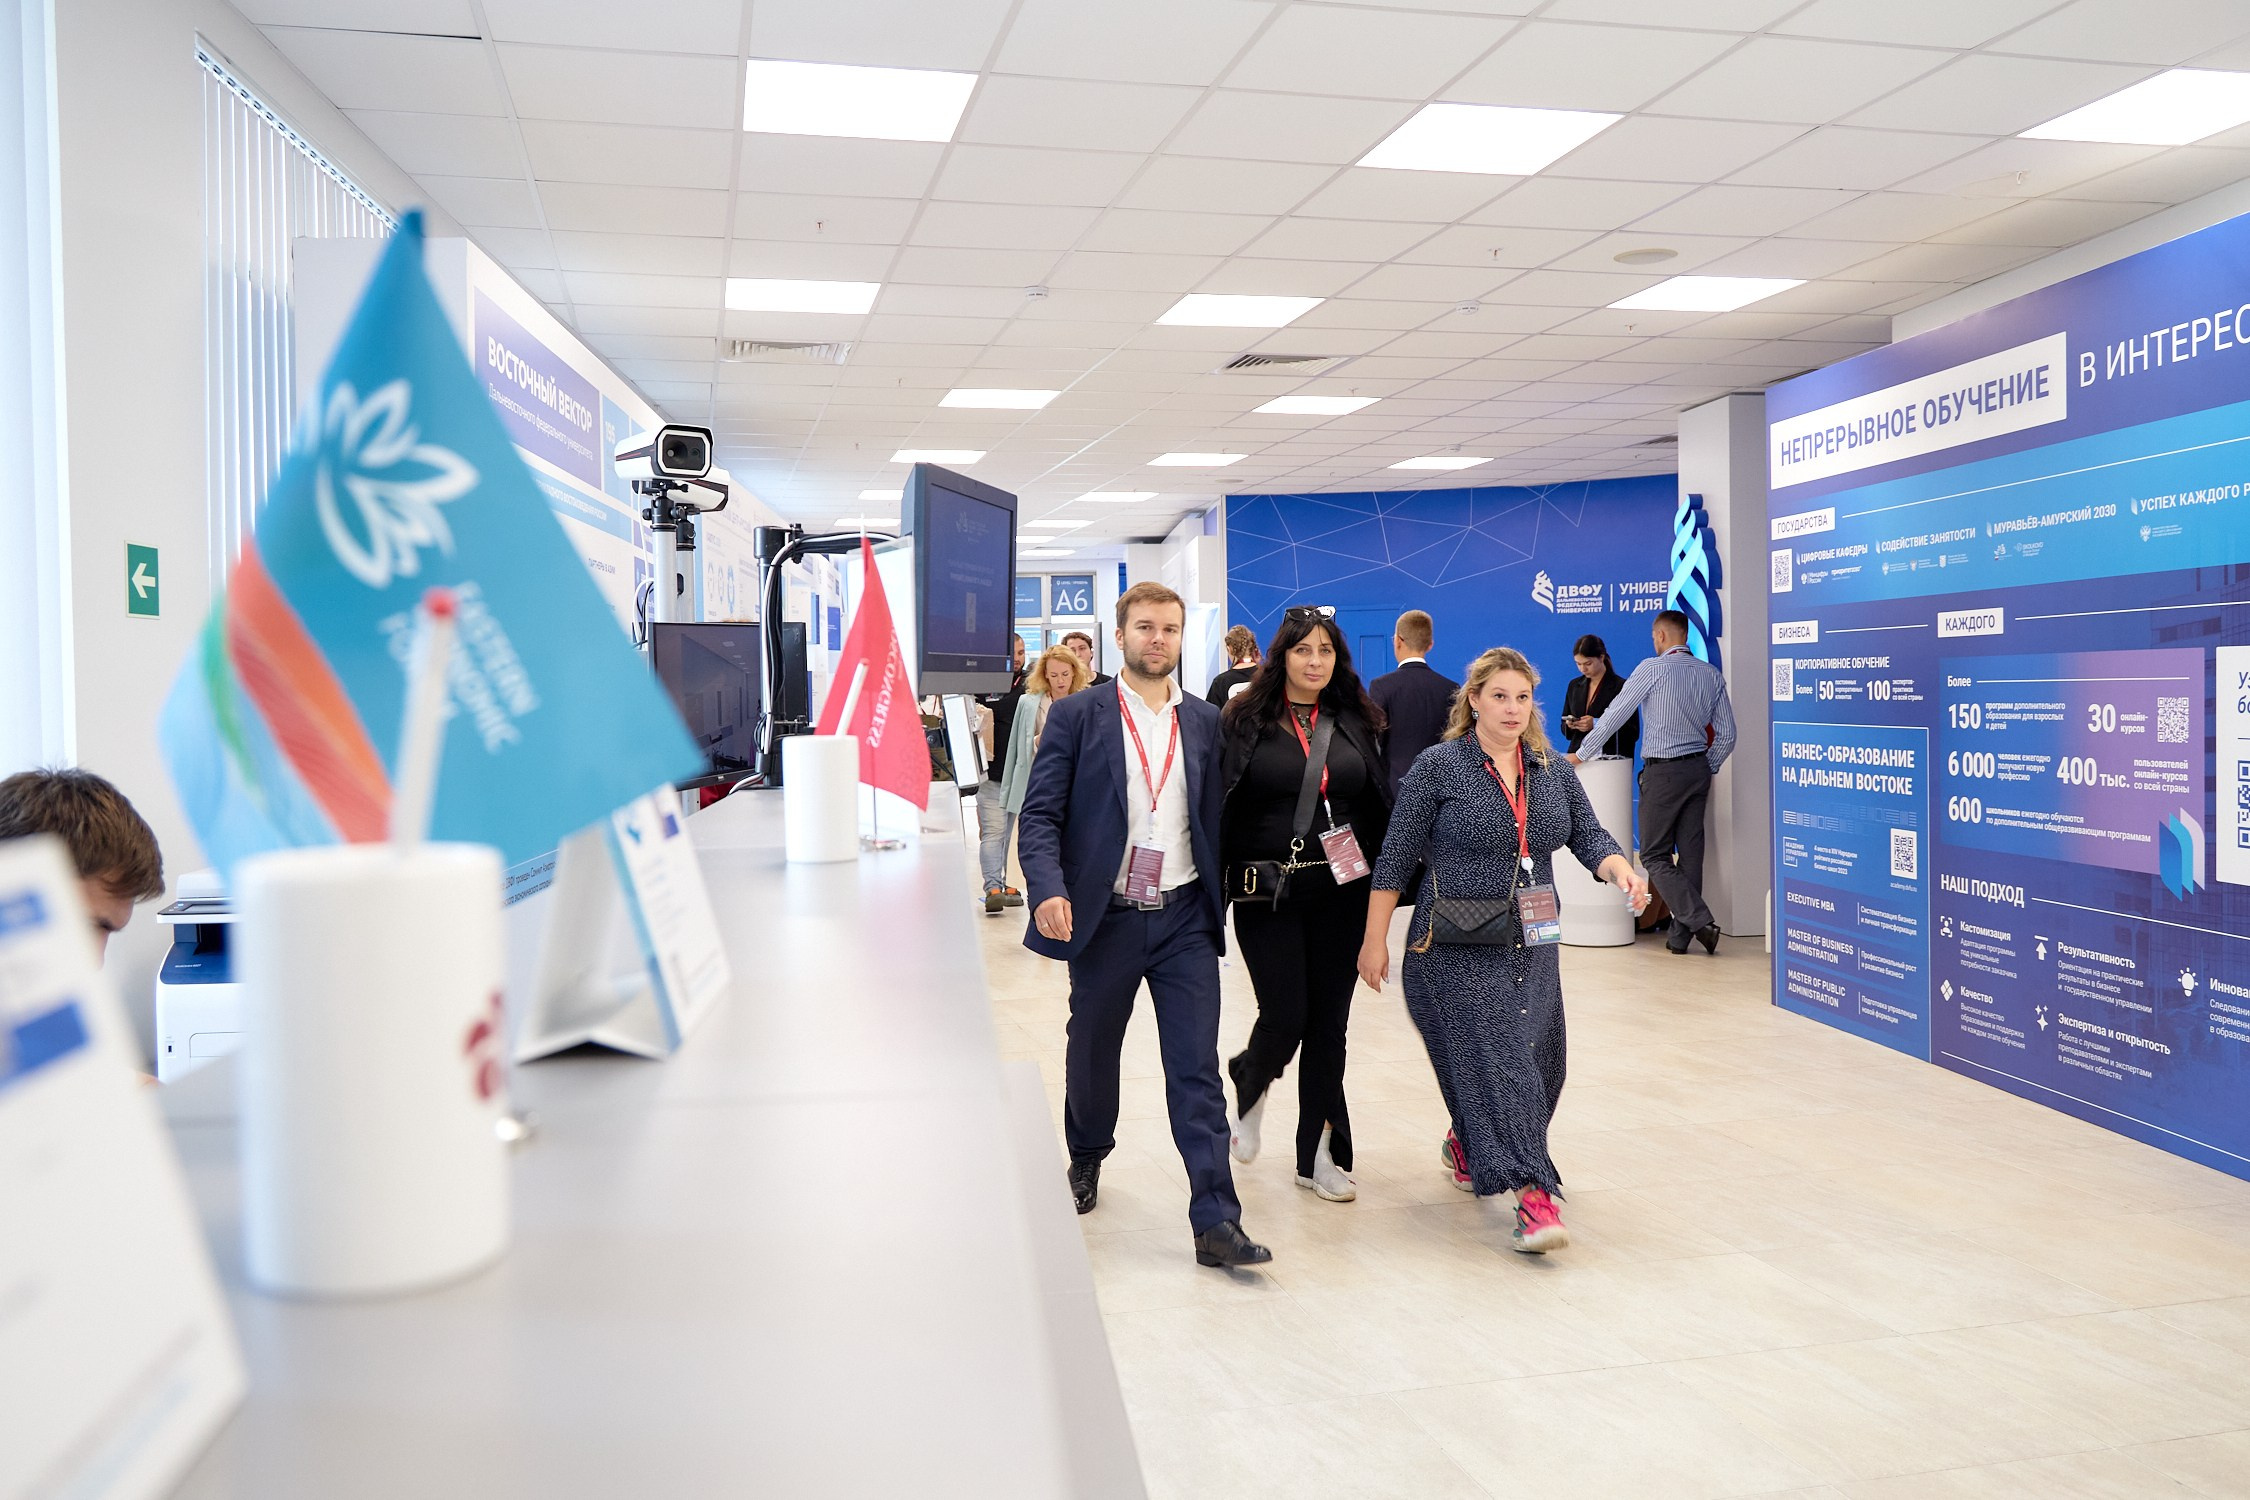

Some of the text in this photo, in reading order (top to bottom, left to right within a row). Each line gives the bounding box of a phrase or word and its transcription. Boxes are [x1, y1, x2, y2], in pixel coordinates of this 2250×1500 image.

[488, 336, 557, 410] ВОСТОЧНЫЙ
[559, 389, 592, 433] ВЕКТОР
[1781, 403, 1916, 467] НЕПРЕРЫВНОЕ
[1923, 364, 2049, 427] ОБУЧЕНИЕ
[2080, 351, 2096, 388] В
[2140, 484, 2240, 513] УСПЕХ КАЖДОГО
[1777, 512, 1828, 535] ГОСУДАРСТВА
[1993, 503, 2117, 535] МУРАВЬЁВ-АМУРСКИЙ 2030
[1881, 527, 1976, 553] СОДЕЙСТВИЕ ЗАНЯТОСТИ
[1801, 544, 1868, 565] ЦИФРОВЫЕ КАФЕДРЫ
[1556, 584, 1602, 598] ДВФУ
[1619, 580, 1672, 595] УНИВЕ
[1055, 588, 1088, 612] A6
[1619, 598, 1663, 613] И ДЛЯ
[1778, 626, 1811, 639] БИЗНЕСА
[1945, 614, 1996, 632] КАЖДОГО
[1795, 656, 1890, 670] КОРПОРАТИВНОЕ ОБУЧЕНИЕ
[1796, 684, 1813, 695] Более
[1819, 680, 1834, 700] 50
[1866, 680, 1891, 701] 100
[1947, 675, 1972, 687] Более
[1948, 703, 1981, 729] 150
[1985, 702, 2065, 711] программ дополнительного
[1985, 711, 2065, 721] образования для взрослых
[2120, 712, 2149, 722] онлайн-
[1990, 721, 2007, 731] детей
[2088, 704, 2116, 733] 30
[2120, 725, 2145, 735] курсов
[1782, 742, 1915, 769] БИЗНЕС-ОБРАЗОВАНИЕ
[1997, 753, 2051, 763] человек ежегодно
[2133, 758, 2189, 770] пользователей
[1997, 762, 2045, 773] получают новую
[1997, 772, 2031, 781] профессию
[2056, 756, 2098, 786] 400
[2133, 770, 2189, 782] онлайн-курсов
[1782, 766, 1913, 795] НА ДАЛЬНЕМ ВОСТОКЕ
[2133, 781, 2190, 794] со всей страны
[1948, 796, 1982, 824] 600
[1985, 807, 2085, 823] школьников ежегодно обучаются
[1985, 816, 2151, 843] по дополнительным общеразвивающим программам
[1940, 873, 2025, 908] НАШ ПОДХОД
[1787, 892, 1836, 912] EXECUTIVE MBA
[1860, 905, 1917, 926] Систематизация бизнеса
[1880, 921, 1917, 936] трансформация
[1960, 920, 2011, 942] Кастомизация
[1787, 928, 1854, 955] MASTER OF BUSINESS
[1960, 938, 2016, 957] Адаптация программы
[1787, 941, 1839, 964] ADMINISTRATION
[1960, 948, 1999, 964] под уникальные
[2057, 941, 2136, 970] Результативность
[1885, 966, 1904, 980] бизнеса
[1960, 959, 2017, 979] потребности заказчика
[2057, 960, 2144, 988] Ориентация на практические
[1788, 969, 1846, 996] MASTER OF PUBLIC
[2057, 972, 2091, 988] результаты
[2096, 980, 2121, 994] бизнесе
[2210, 977, 2250, 998] Иннова
[1788, 982, 1839, 1008] ADMINISTRATION
[1960, 986, 1994, 1005] Качество
[2063, 985, 2115, 1004] государственном
[2115, 997, 2153, 1014] управлении
[1960, 1002, 2005, 1022] Высокое качество
[1960, 1013, 1992, 1029] образования
[1995, 1024, 2025, 1039] поддержка
[2057, 1012, 2171, 1055] Экспертиза и открытость
[2210, 1025, 2215, 1033] в
[1960, 1024, 2026, 1050] на каждом этапе обучения
[2057, 1031, 2111, 1053] Работа с лучшими
[2057, 1043, 2152, 1079] преподавателями и экспертами
[2062, 1056, 2094, 1072] различных
[2094, 1066, 2123, 1081] областях
